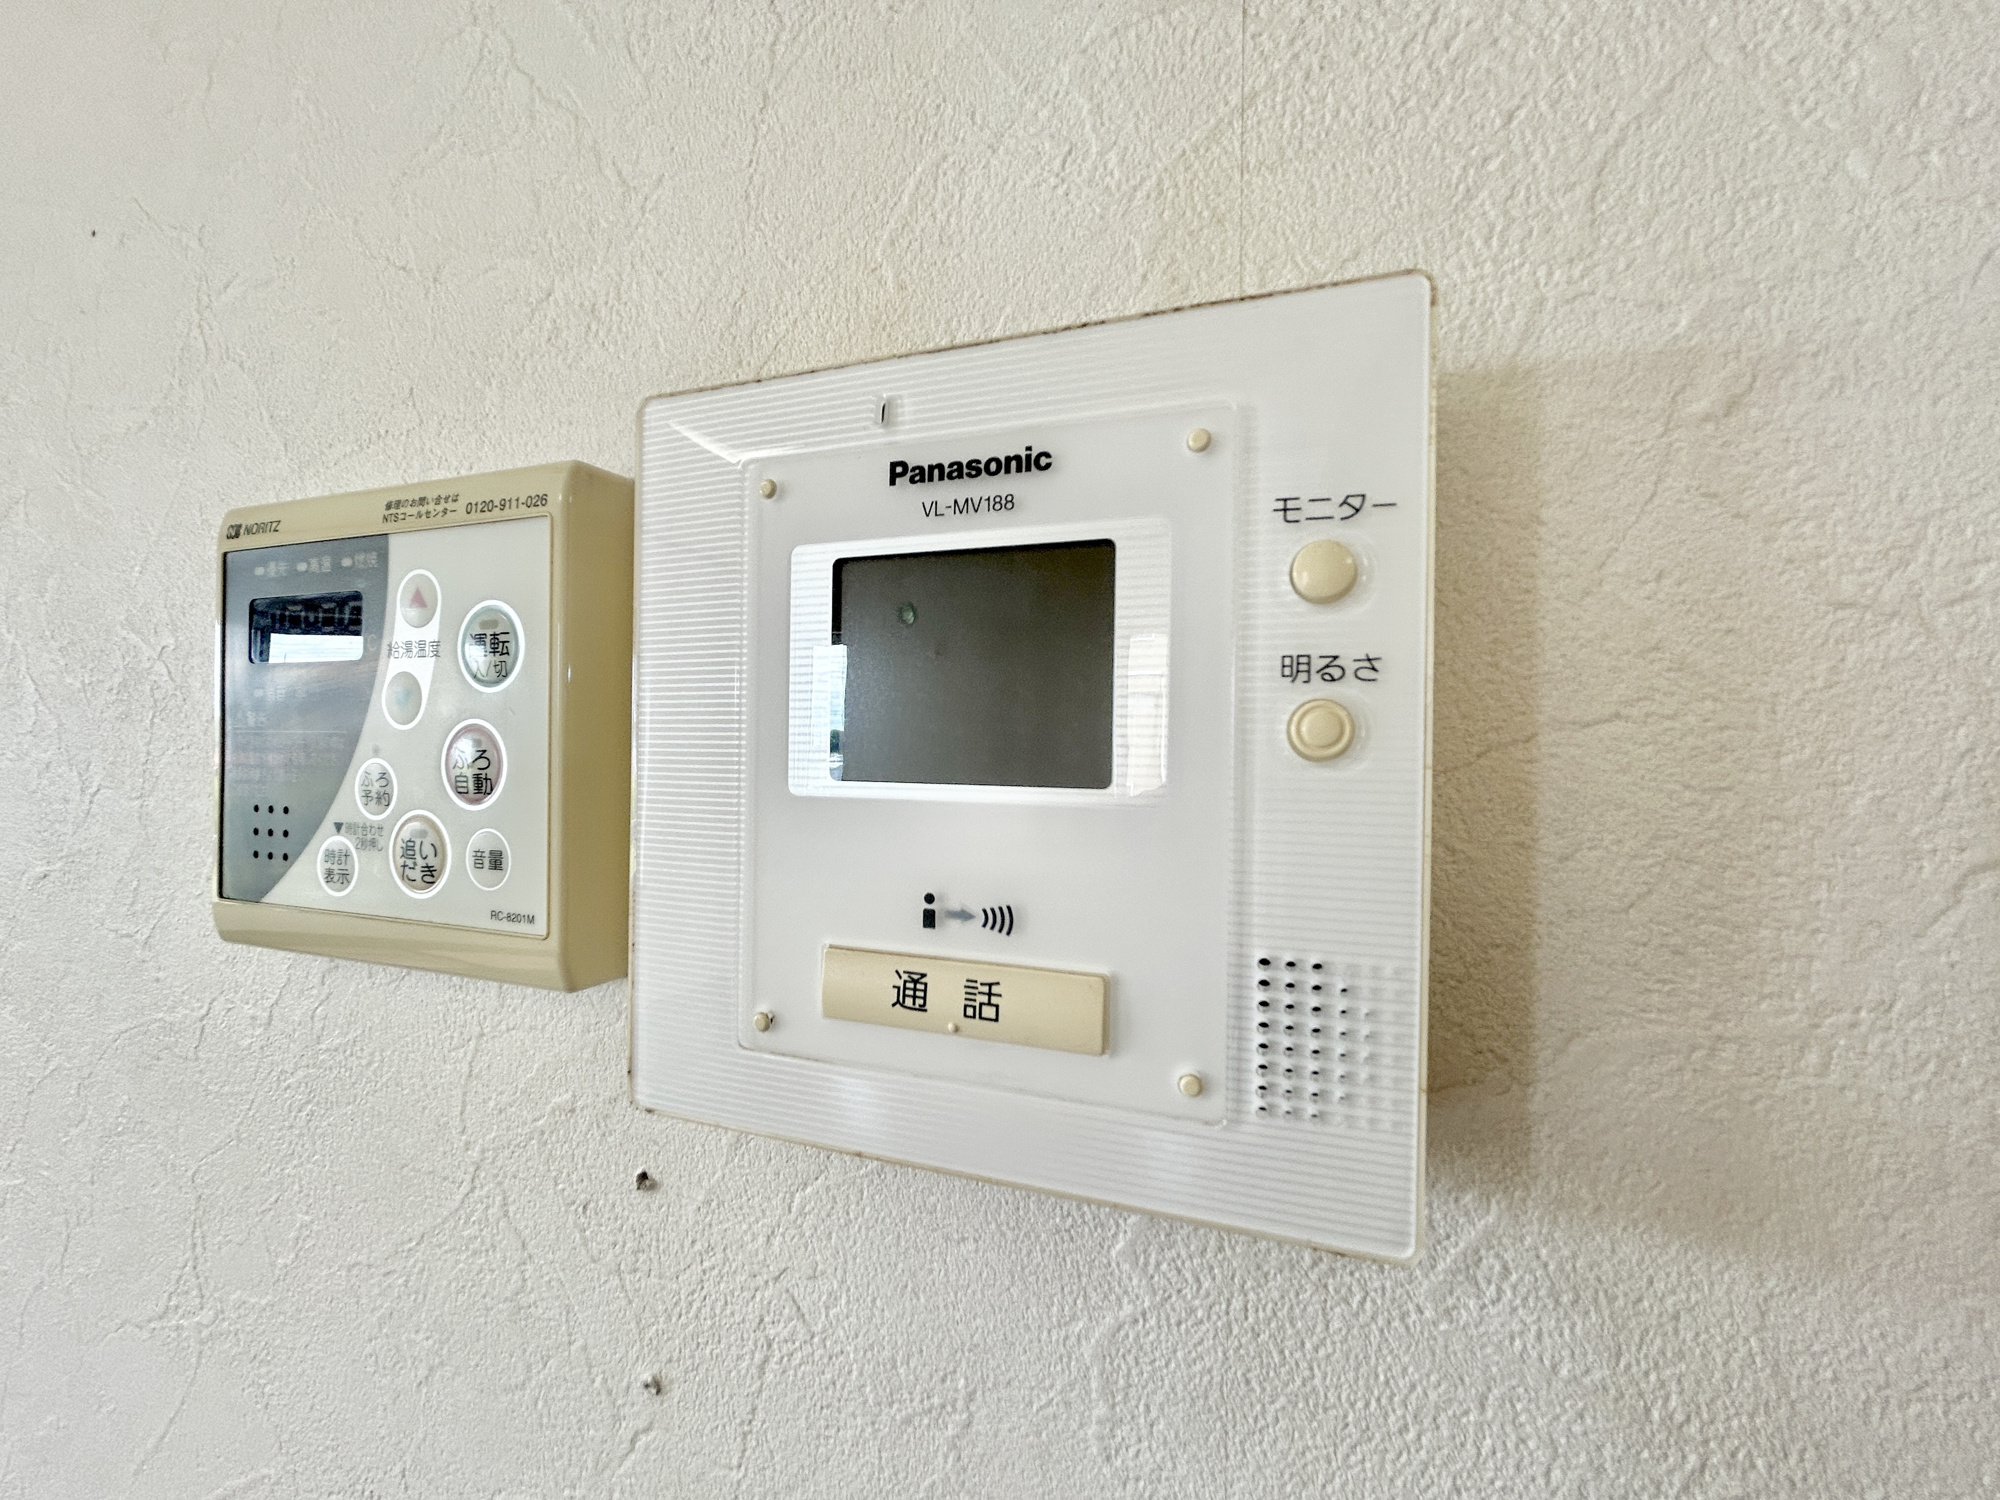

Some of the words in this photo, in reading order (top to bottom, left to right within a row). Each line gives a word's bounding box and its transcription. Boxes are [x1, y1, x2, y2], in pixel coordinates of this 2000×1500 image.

[889, 445, 1053, 486] Panasonic
[465, 493, 548, 515] 0120-911-026
[921, 493, 1015, 517] VL-MV188
[1273, 493, 1398, 523] モニター
[382, 508, 457, 524] NTSコールセンター
[243, 519, 282, 536] NORITZ
[387, 640, 441, 659] 給湯温度
[1281, 653, 1382, 684] 明るさ
[453, 747, 491, 771] ふろ
[361, 771, 390, 788] ふろ
[454, 772, 493, 796] 自動
[361, 789, 390, 807] 予約
[324, 848, 351, 866] 時計
[400, 838, 437, 860] 追い
[472, 848, 504, 871] 音量
[324, 867, 351, 885] 表示
[400, 860, 437, 884] だき
[490, 910, 535, 925] RC-8201M
[891, 969, 1002, 1022] 通話
